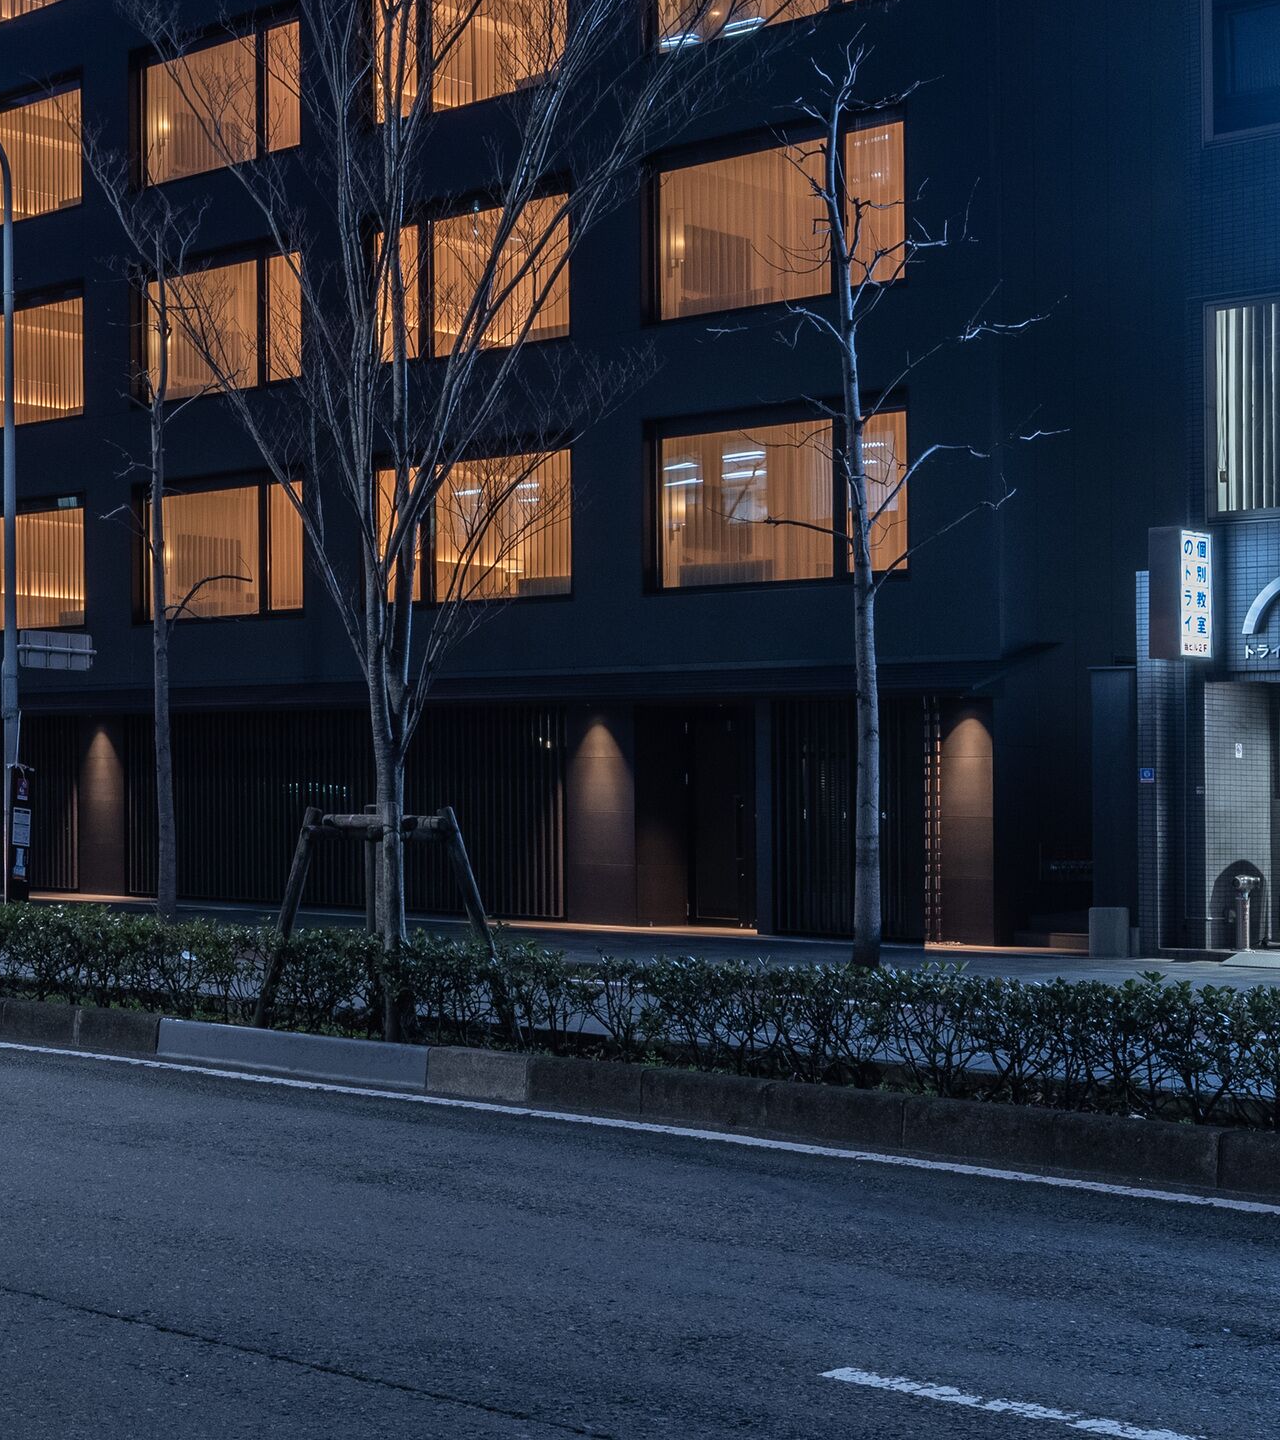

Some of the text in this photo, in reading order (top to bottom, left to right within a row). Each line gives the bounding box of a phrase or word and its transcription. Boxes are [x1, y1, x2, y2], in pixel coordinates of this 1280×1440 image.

[1183, 539, 1193, 632] のトライ
[1196, 541, 1207, 634] 個別教室
